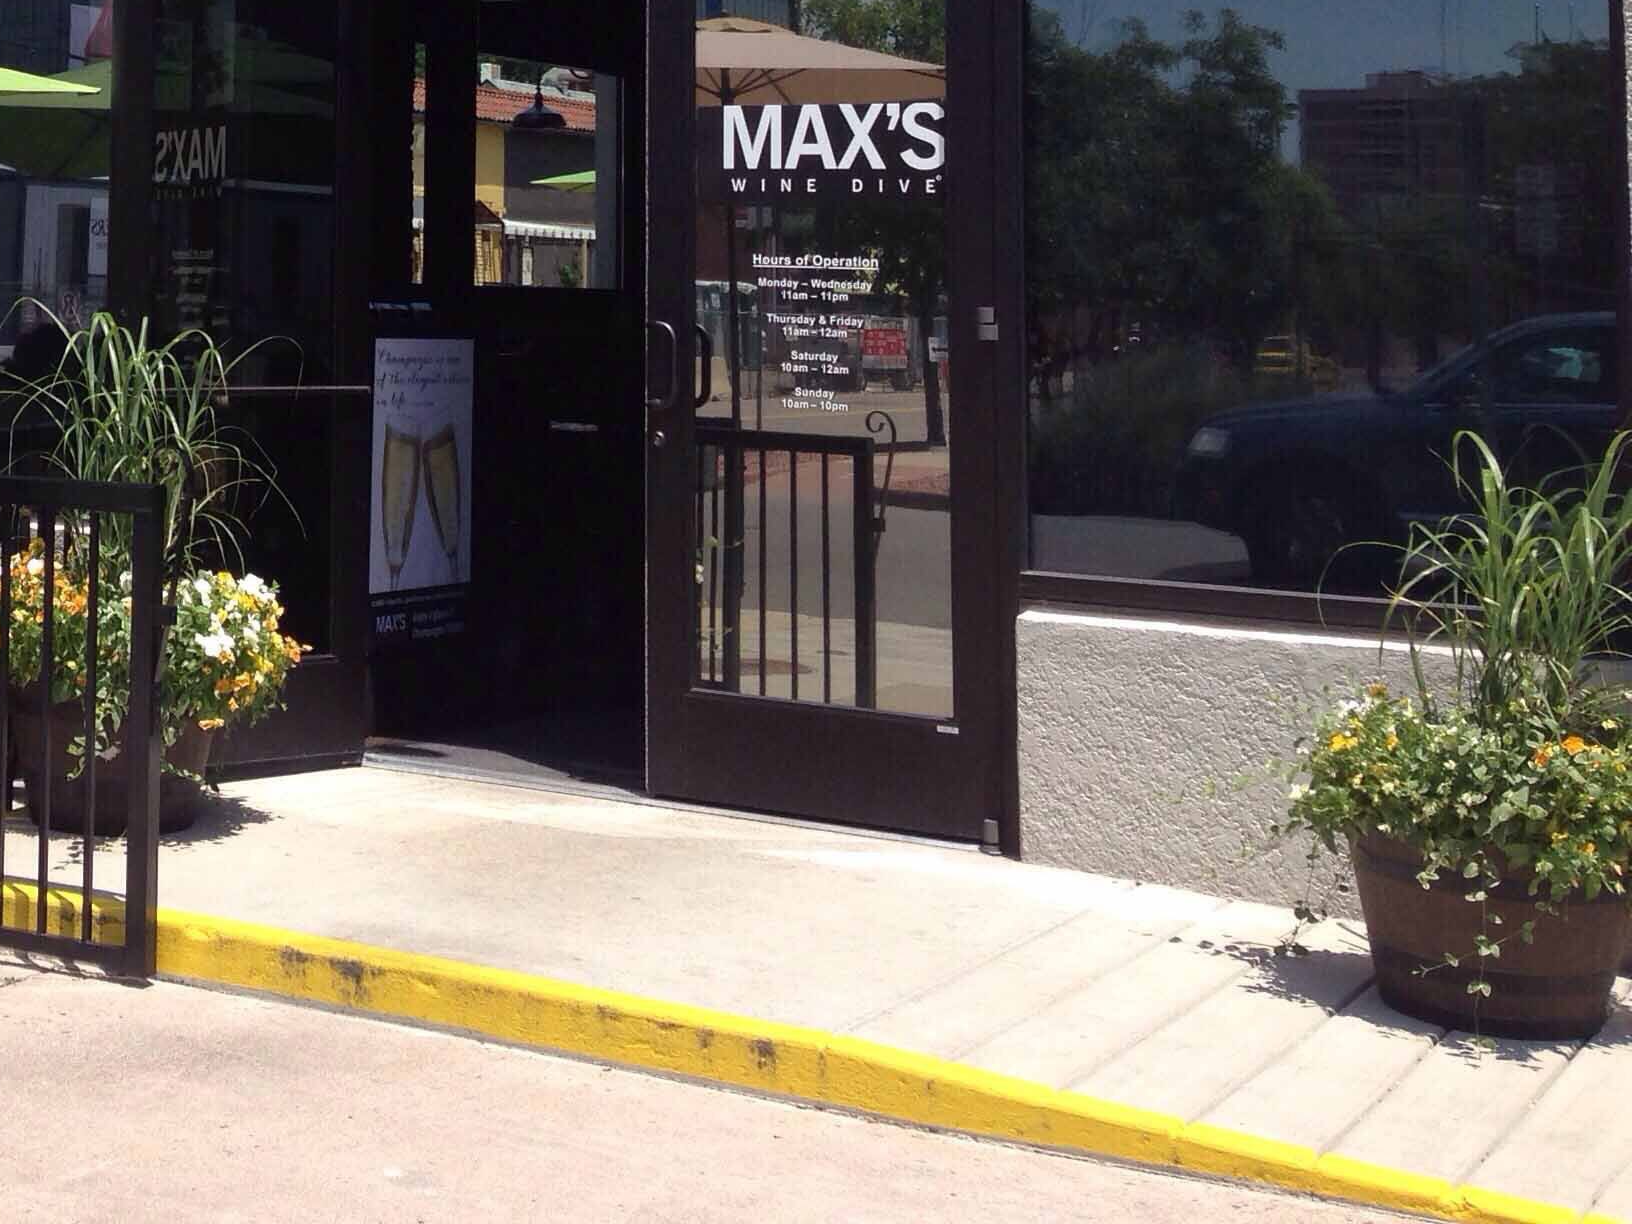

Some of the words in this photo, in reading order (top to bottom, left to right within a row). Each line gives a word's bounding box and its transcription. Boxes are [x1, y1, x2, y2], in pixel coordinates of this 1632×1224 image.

[723, 102, 945, 170] MAX'S
[731, 178, 817, 193] WINE
[753, 253, 791, 266] Hours
[795, 254, 810, 266] of
[812, 255, 879, 270] Operation
[757, 277, 799, 289] Monday
[810, 279, 872, 292] Wednesday
[781, 290, 808, 300] 11am
[820, 291, 849, 303] 11pm
[767, 313, 816, 326] Thursday
[818, 316, 827, 325] &
[830, 316, 864, 328] Friday
[782, 327, 809, 337] 11am
[819, 328, 848, 338] 12am
[791, 350, 838, 364] Saturday
[780, 362, 809, 373] 10am
[821, 364, 849, 374] 12am
[794, 387, 835, 400] Sunday
[781, 398, 809, 409] 10am
[819, 401, 849, 412] 10pm
